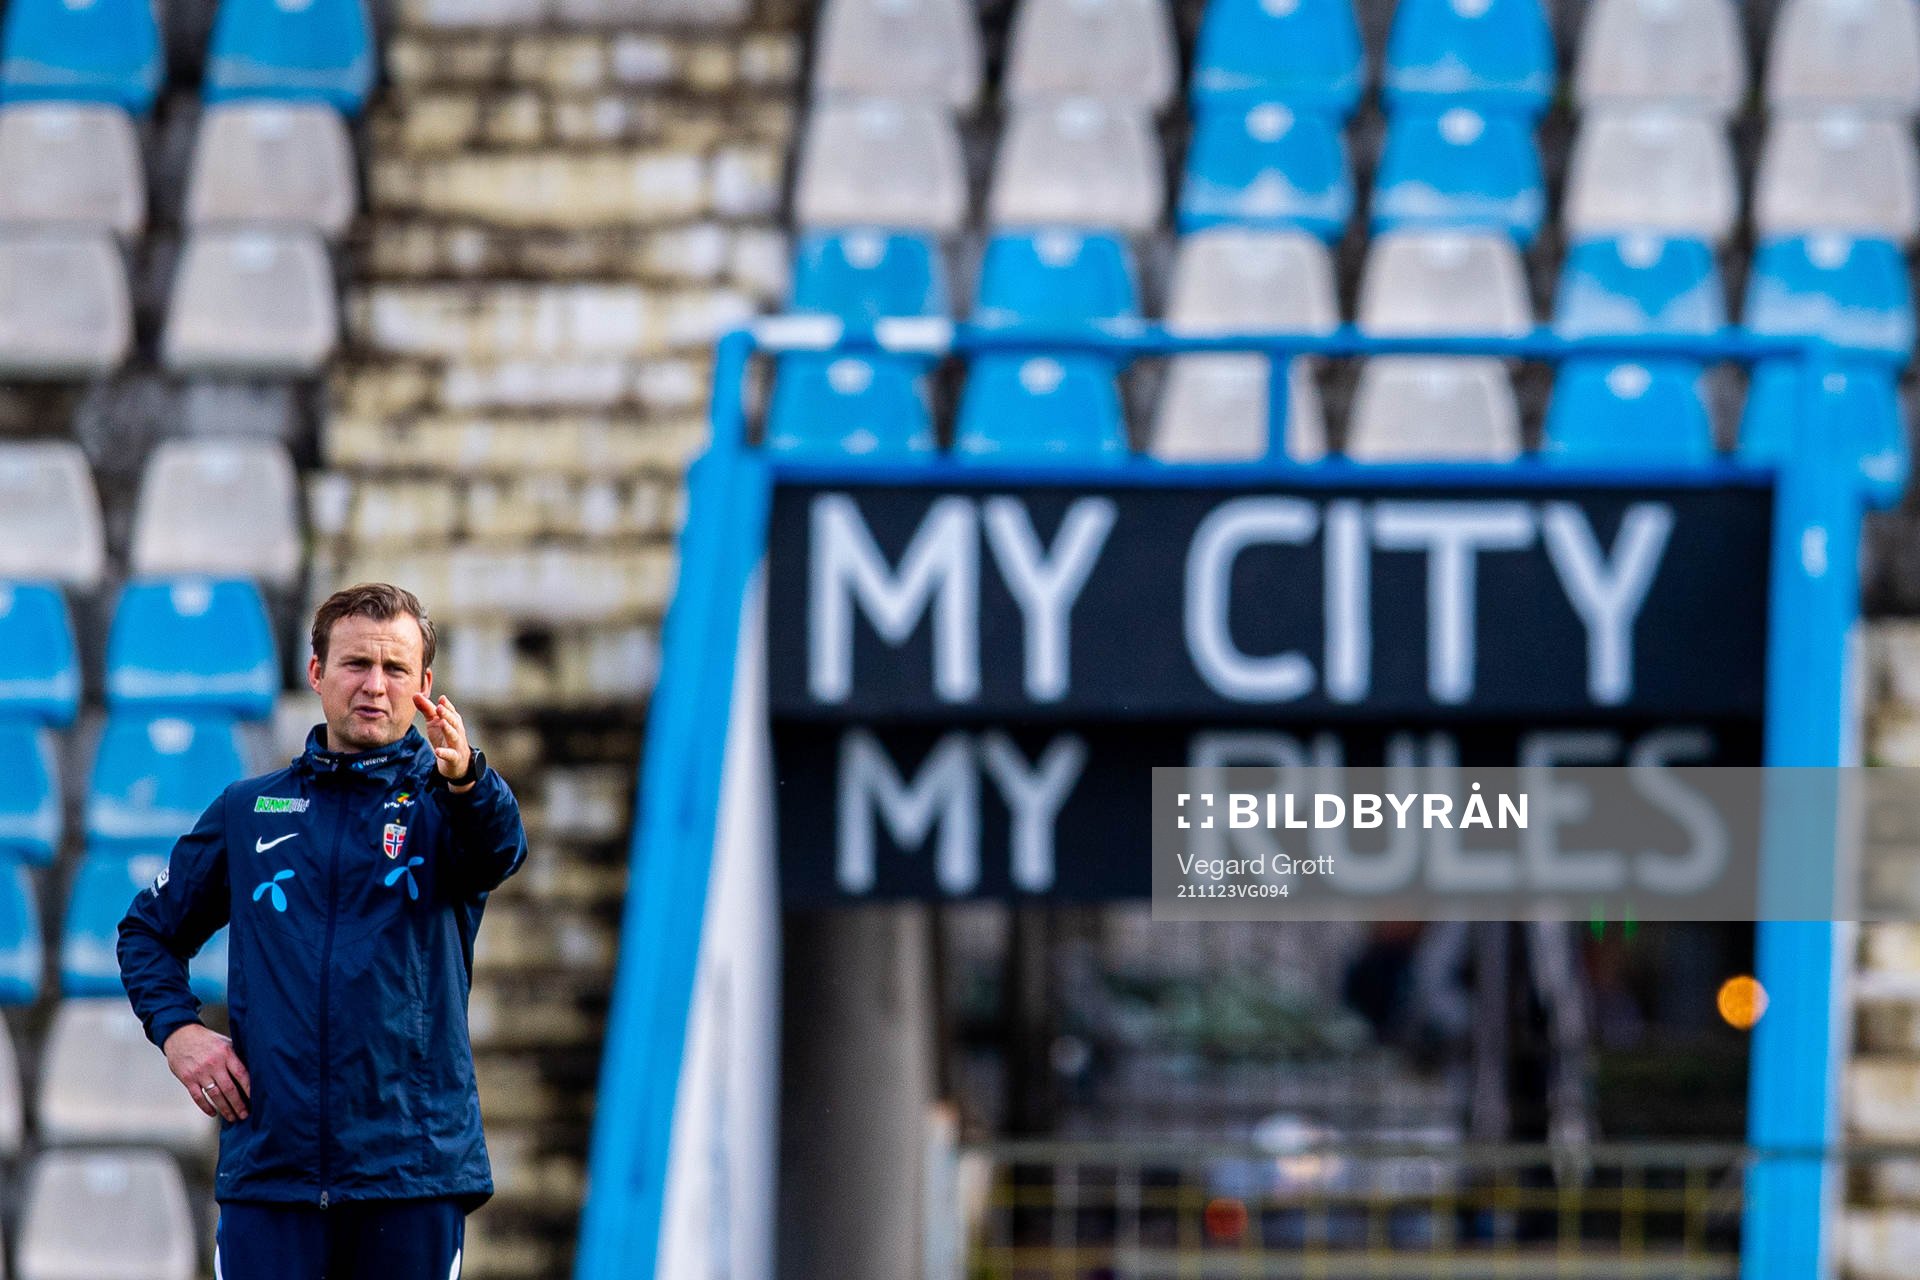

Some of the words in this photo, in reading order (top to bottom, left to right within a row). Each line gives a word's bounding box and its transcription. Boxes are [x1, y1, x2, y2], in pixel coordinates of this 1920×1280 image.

[810, 493, 1117, 704] MY
[1184, 495, 1673, 706] CITY
[835, 729, 1088, 894] MY
[1187, 729, 1728, 895] RULES
